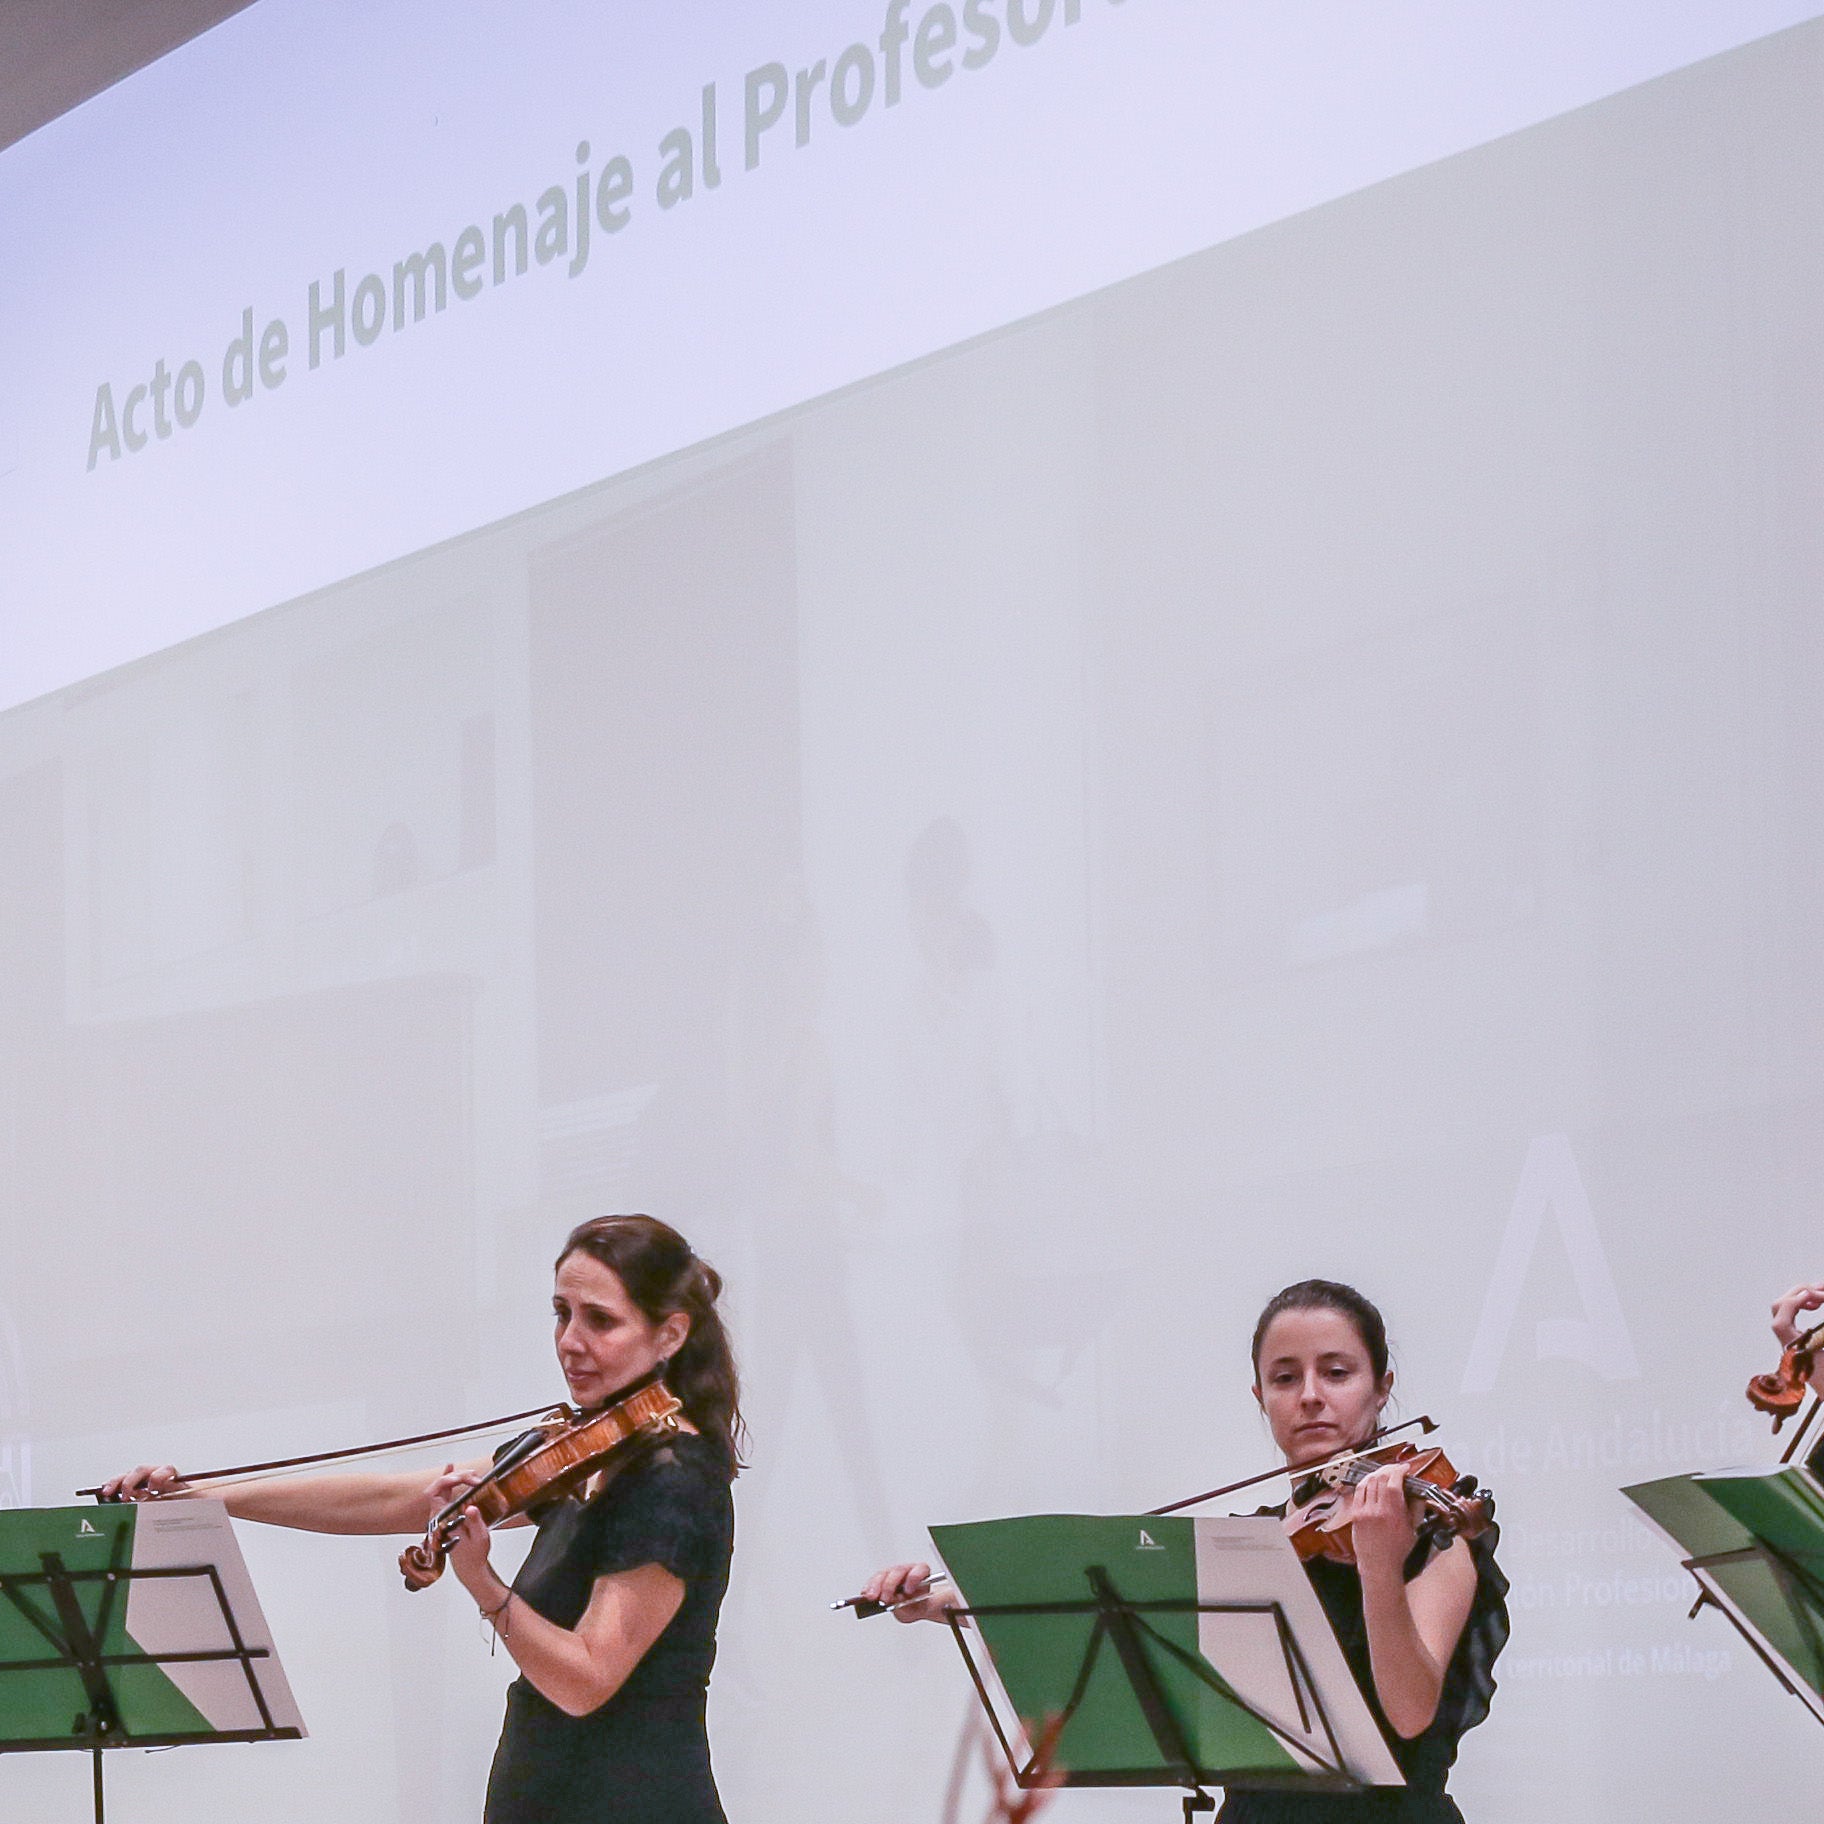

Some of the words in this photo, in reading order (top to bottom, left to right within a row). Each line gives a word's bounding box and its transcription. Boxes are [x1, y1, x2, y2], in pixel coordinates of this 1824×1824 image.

[86, 358, 205, 472] Acto
[222, 306, 289, 407] de
[308, 140, 634, 371] Homenaje
[656, 82, 721, 210] al
[744, 0, 1126, 190] Profeso
[1542, 1398, 1755, 1472] Andalucía
[1565, 1568, 1695, 1608] Profesion
